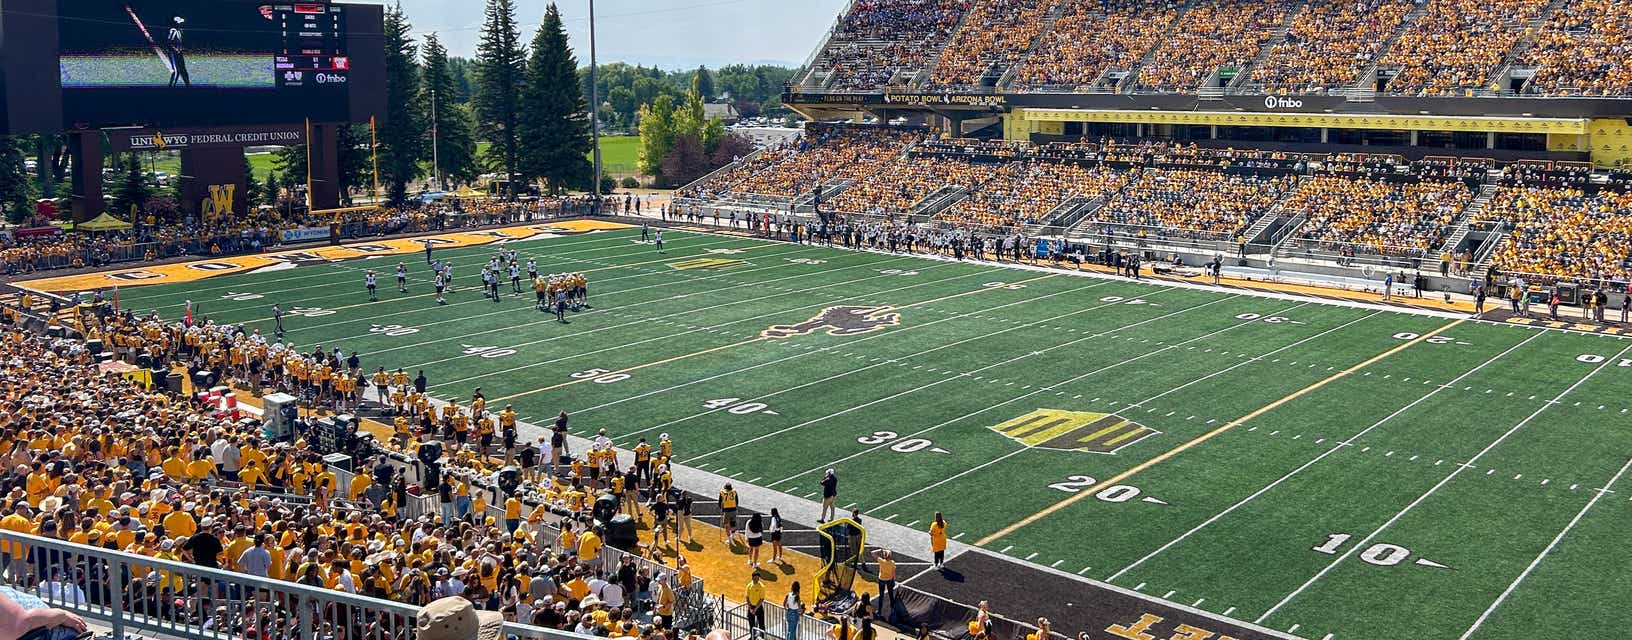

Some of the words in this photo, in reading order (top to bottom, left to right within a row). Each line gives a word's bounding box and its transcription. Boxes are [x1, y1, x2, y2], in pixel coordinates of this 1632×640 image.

[327, 74, 346, 82] fnbo
[890, 95, 920, 103] POTATO
[921, 95, 942, 103] BOWL
[951, 95, 983, 103] ARIZONA
[1278, 97, 1302, 108] fnbo
[191, 134, 233, 144] FEDERAL
[234, 133, 269, 142] CREDIT
[270, 132, 300, 140] UNION
[208, 184, 236, 218] W
[369, 324, 419, 336] 30
[1392, 332, 1455, 344] 20
[462, 345, 518, 358] 40
[569, 368, 632, 383] 50
[702, 397, 768, 414] 40
[856, 431, 934, 453] 30
[1047, 475, 1143, 502] 20
[1312, 533, 1411, 567] 10
